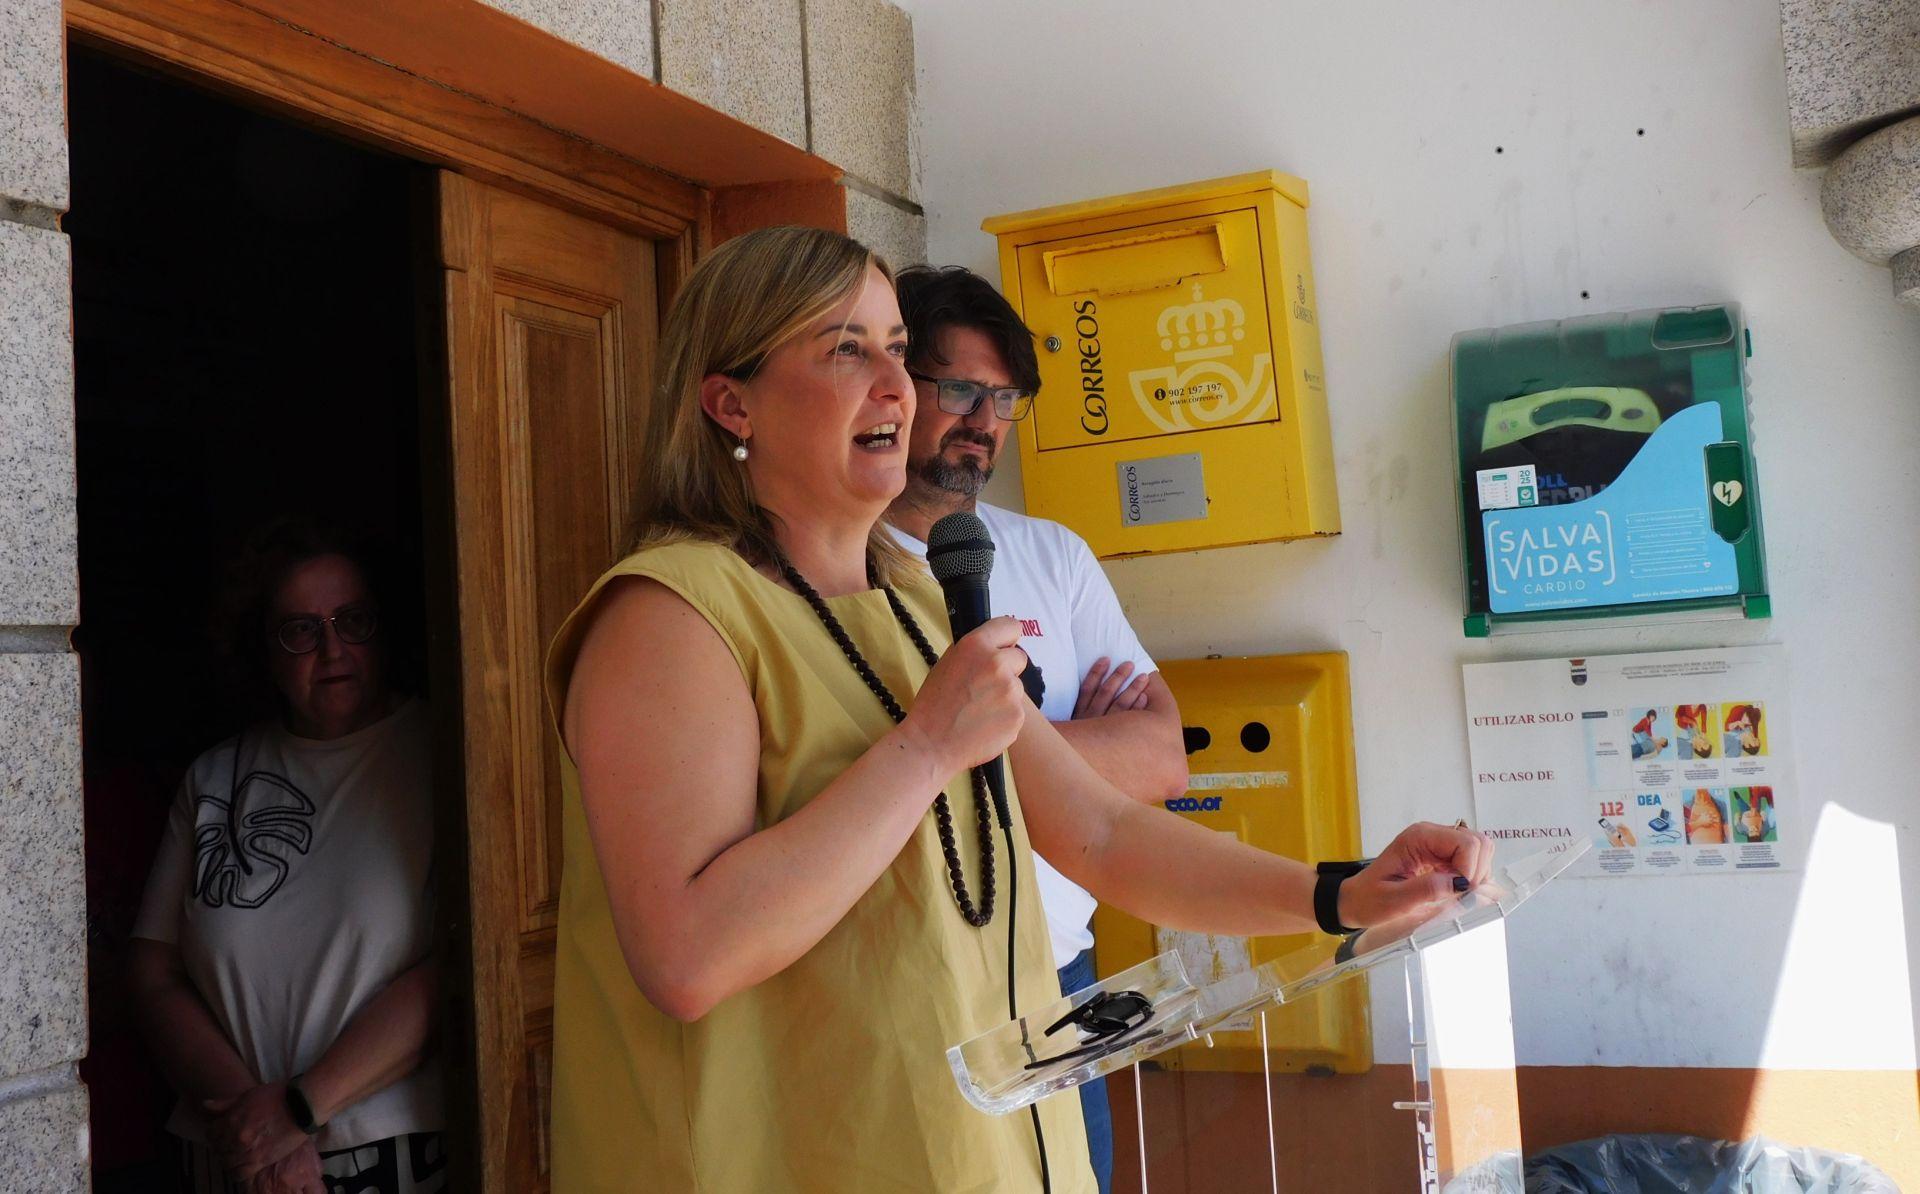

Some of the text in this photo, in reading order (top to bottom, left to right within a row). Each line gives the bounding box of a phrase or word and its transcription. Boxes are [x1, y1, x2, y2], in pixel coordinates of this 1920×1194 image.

[1073, 300, 1109, 436] CORREOS
[1168, 383, 1222, 397] 902 197 197
[1126, 466, 1141, 522] CORREOS
[1499, 523, 1602, 552] SALVA
[1500, 550, 1605, 580] VIDAS
[1523, 579, 1586, 595] CARDIO
[1474, 714, 1536, 727] UTILIZAR
[1538, 712, 1574, 723] SOLO
[1479, 770, 1555, 783] EN CASO DE
[1600, 794, 1662, 817] 112 DEA
[1483, 827, 1572, 840] EMERGENCIA
